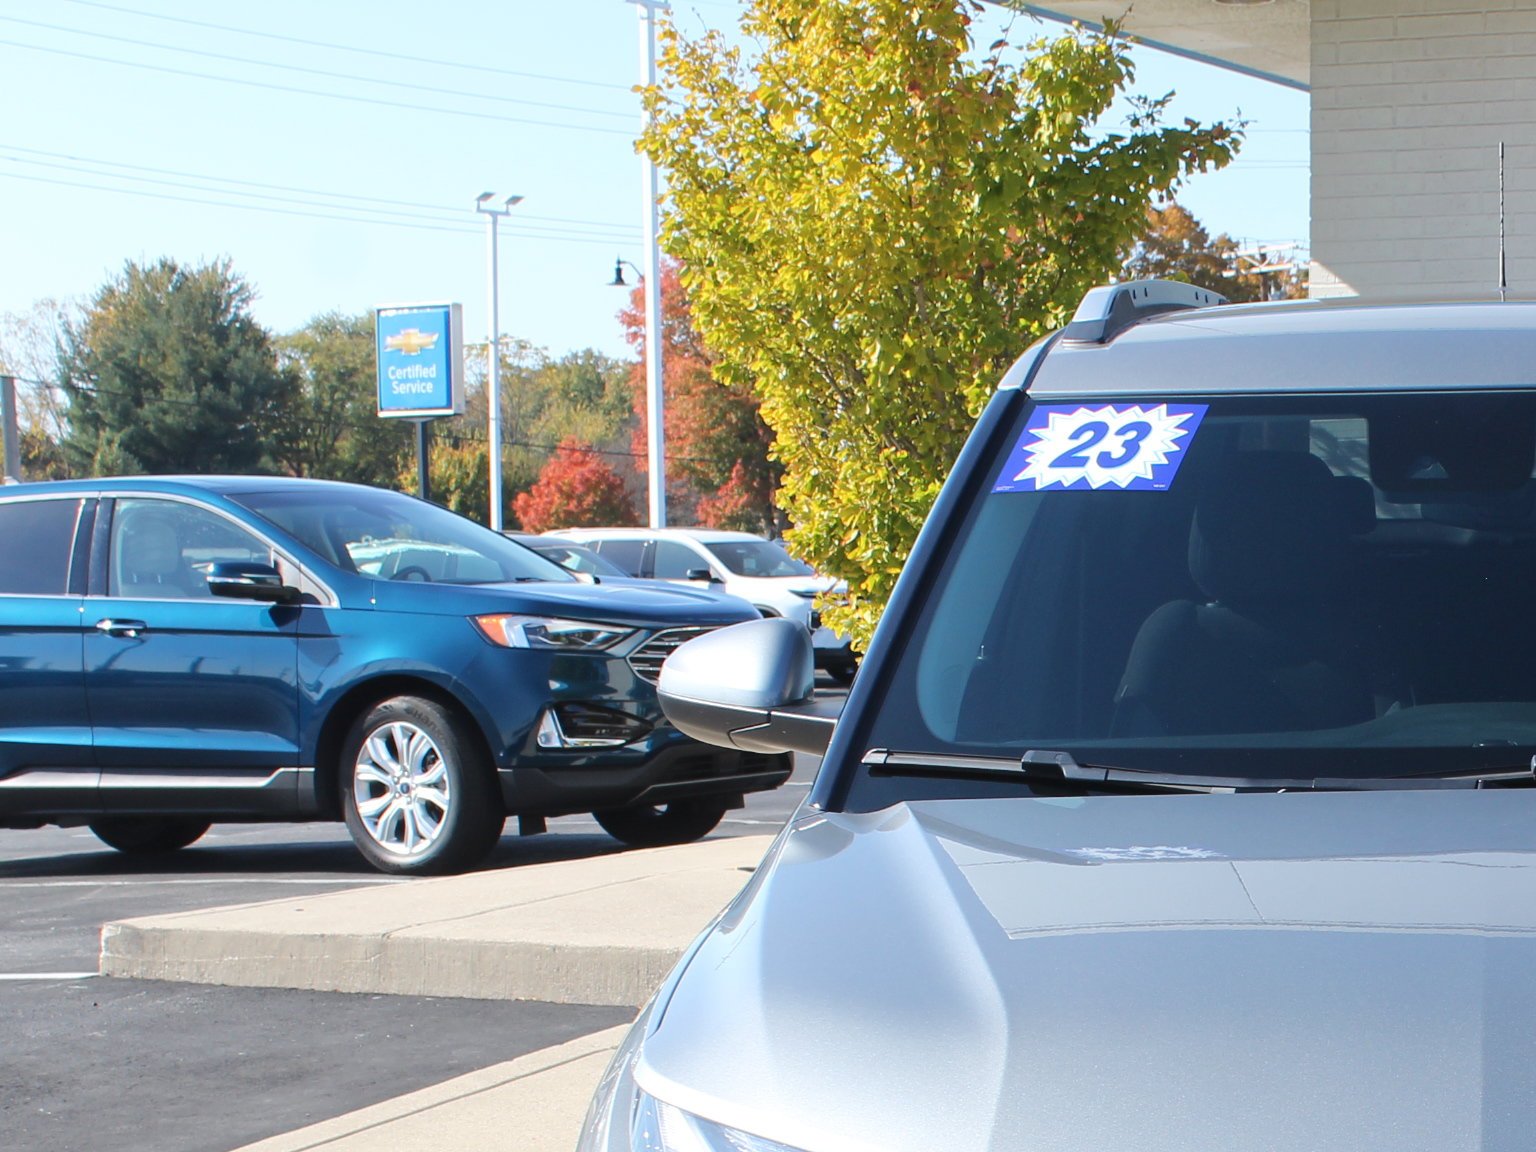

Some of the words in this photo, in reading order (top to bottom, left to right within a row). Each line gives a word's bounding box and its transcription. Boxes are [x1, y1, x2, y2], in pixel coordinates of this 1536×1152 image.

[388, 363, 437, 379] Certified
[392, 380, 434, 394] Service
[1048, 420, 1153, 469] 23
